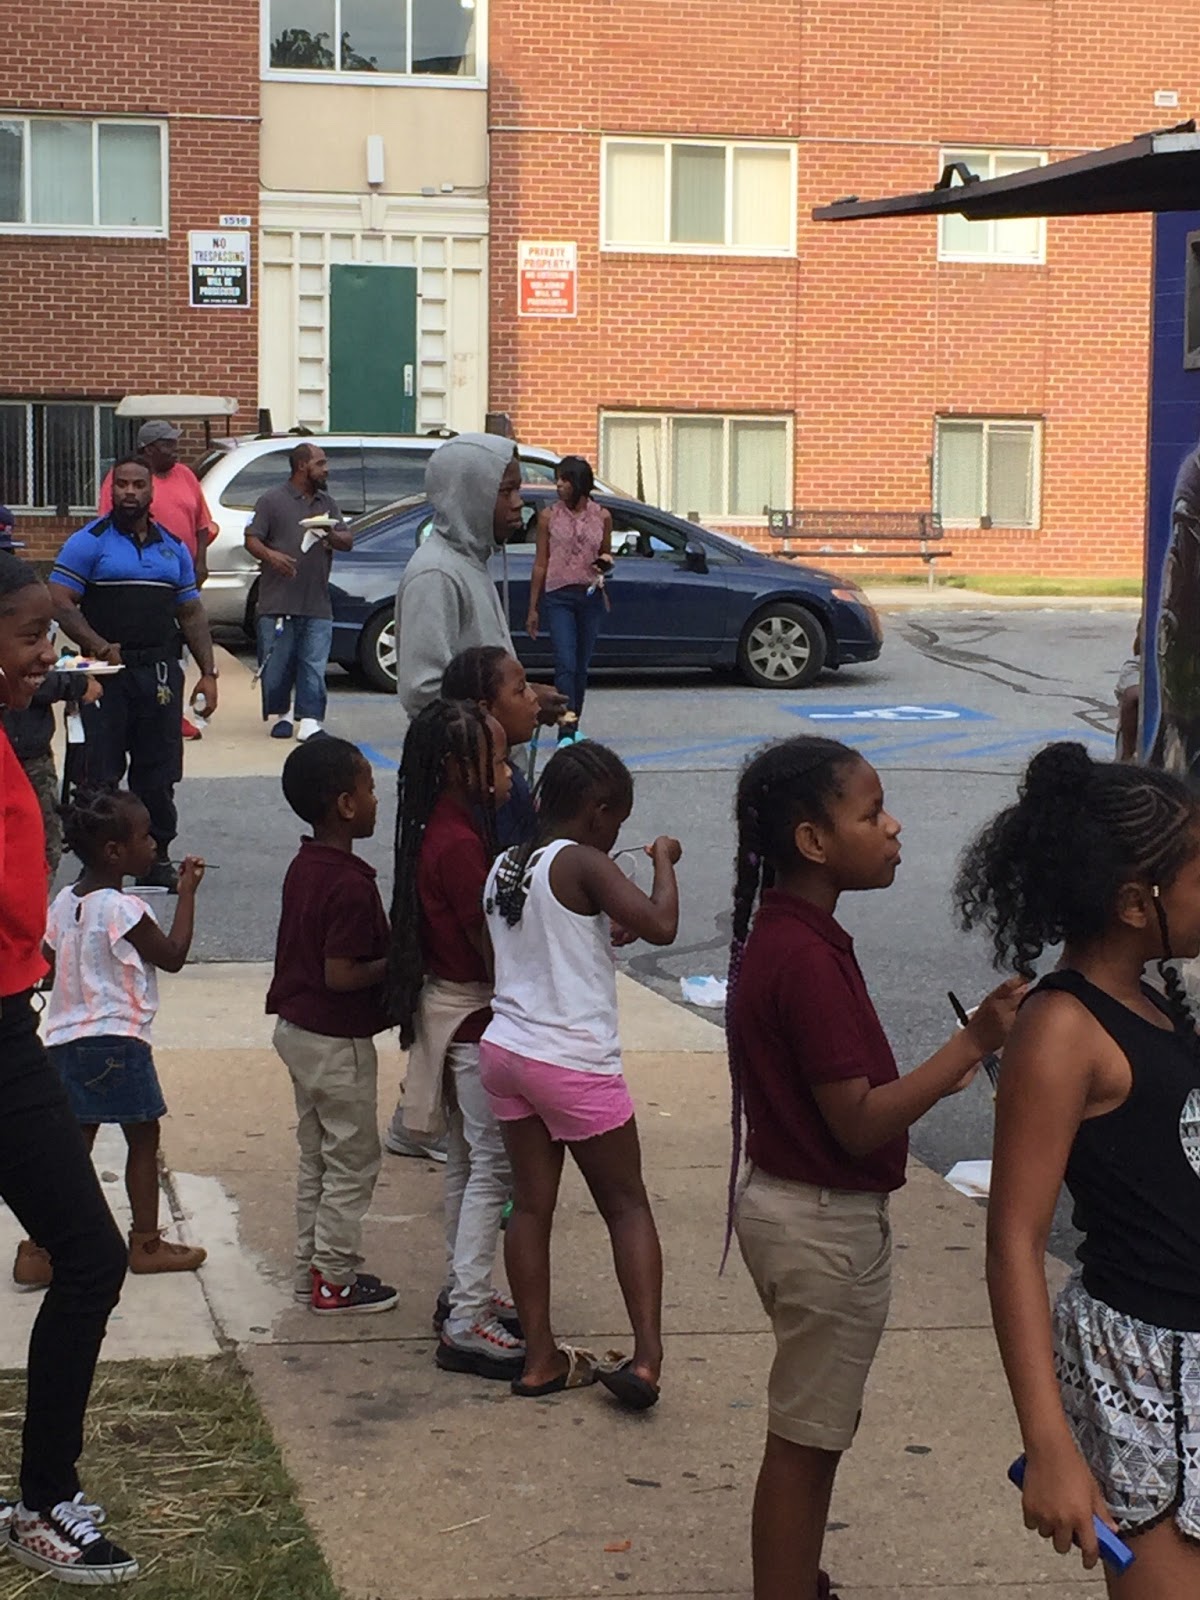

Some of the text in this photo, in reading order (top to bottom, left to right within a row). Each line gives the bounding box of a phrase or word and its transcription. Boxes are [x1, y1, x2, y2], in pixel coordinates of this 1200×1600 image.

[212, 238, 227, 249] NO
[194, 251, 245, 262] TRESPASSING
[528, 247, 566, 257] PRIVATE
[524, 259, 570, 268] PROPERTY
[198, 267, 242, 277] VIOLATORS
